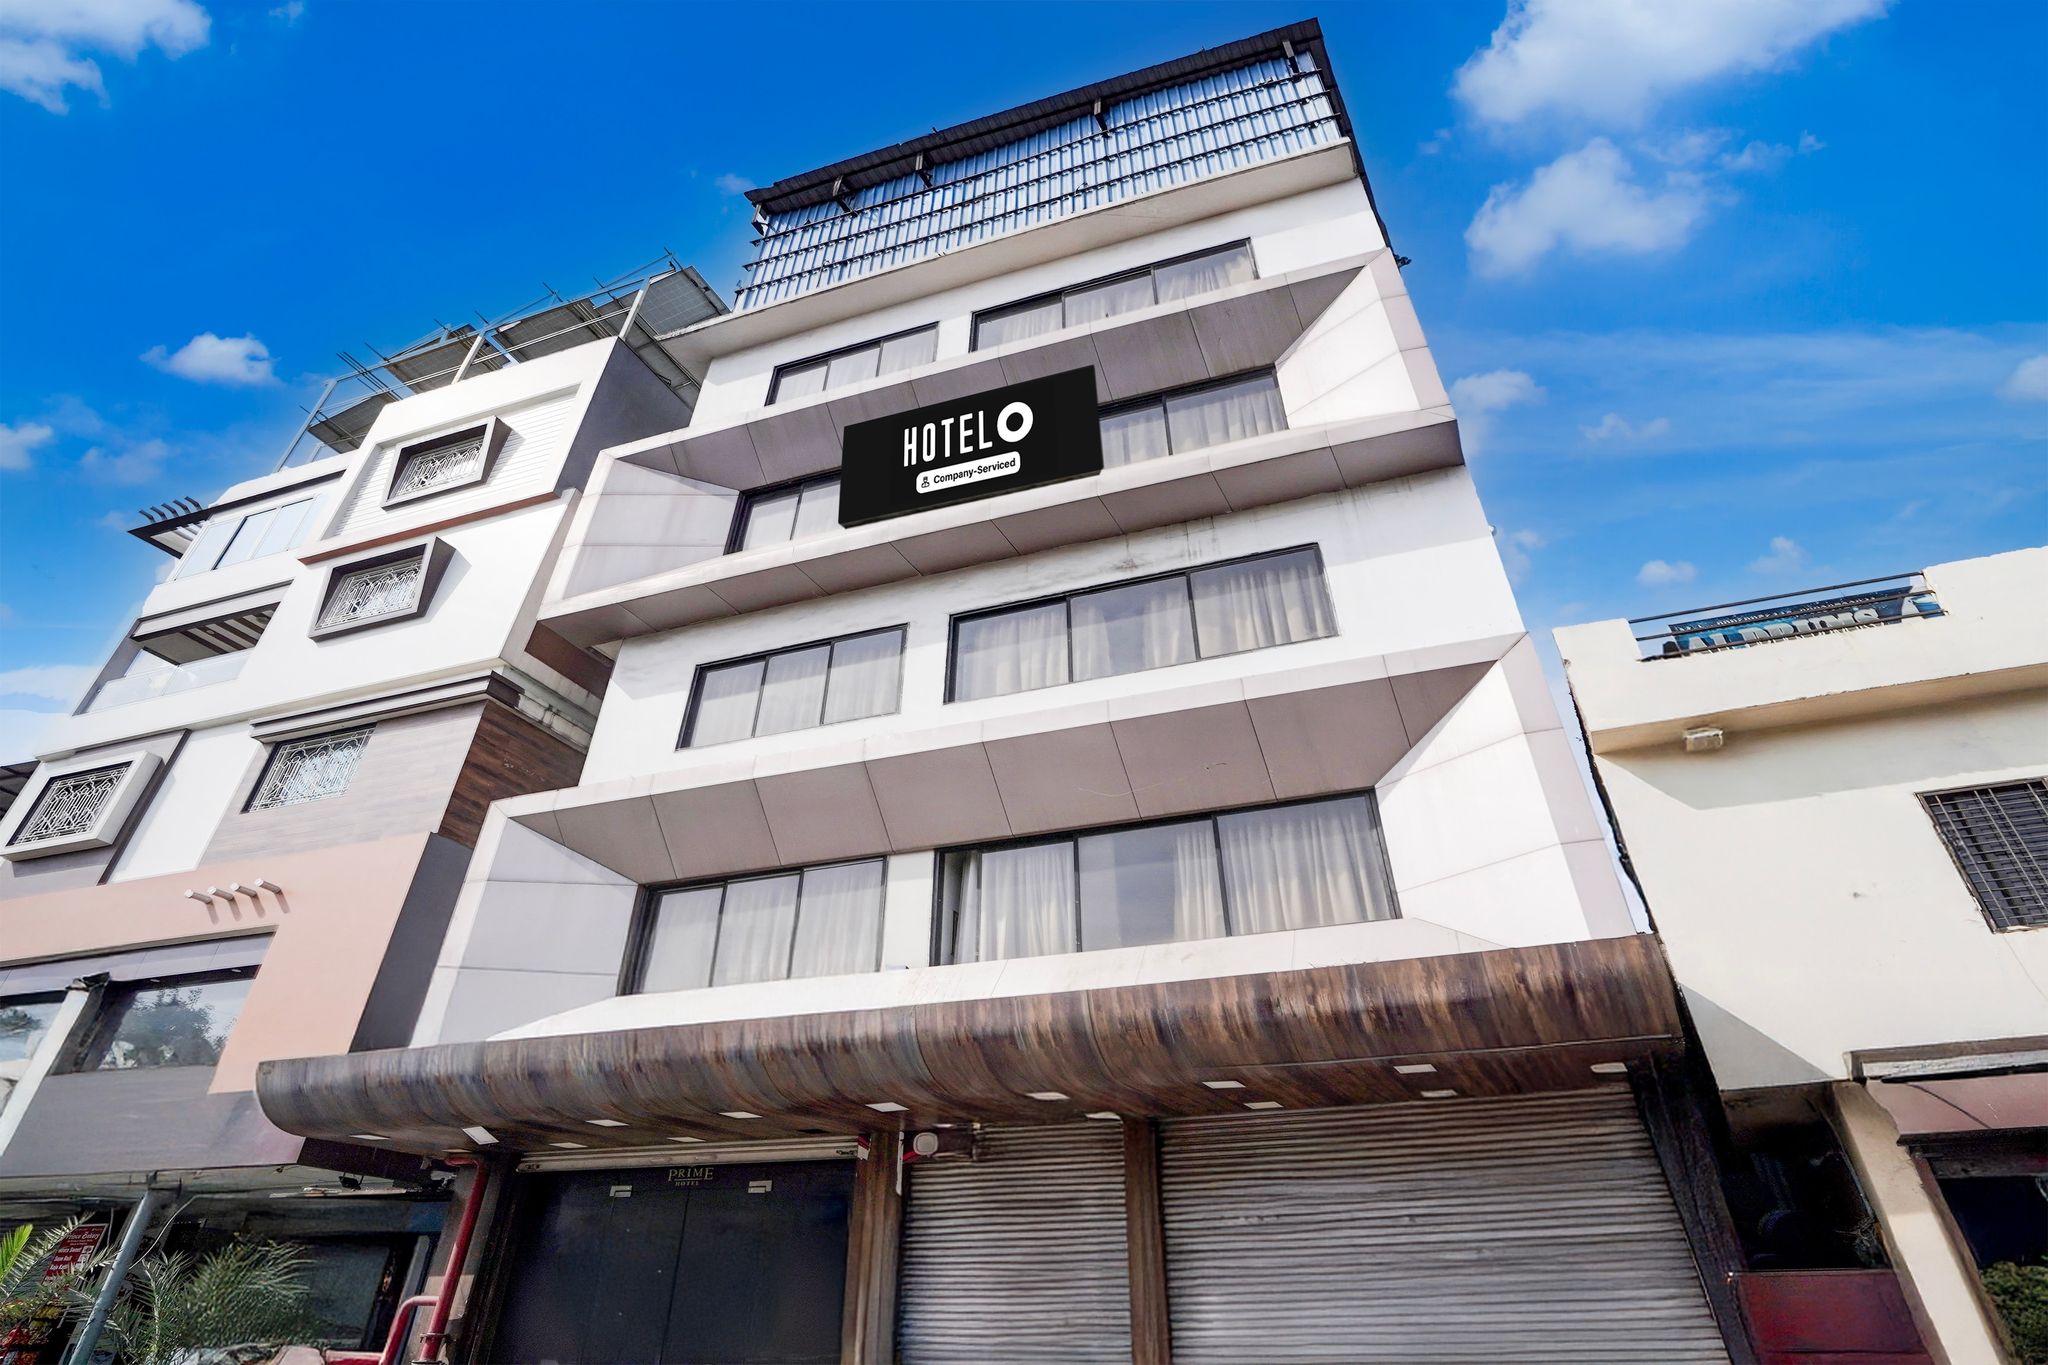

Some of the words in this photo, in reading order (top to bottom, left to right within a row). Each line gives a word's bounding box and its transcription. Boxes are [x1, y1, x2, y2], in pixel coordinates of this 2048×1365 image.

[903, 410, 993, 468] HOTEL
[933, 458, 1016, 484] Company-Serviced
[668, 1167, 714, 1182] PRIME
